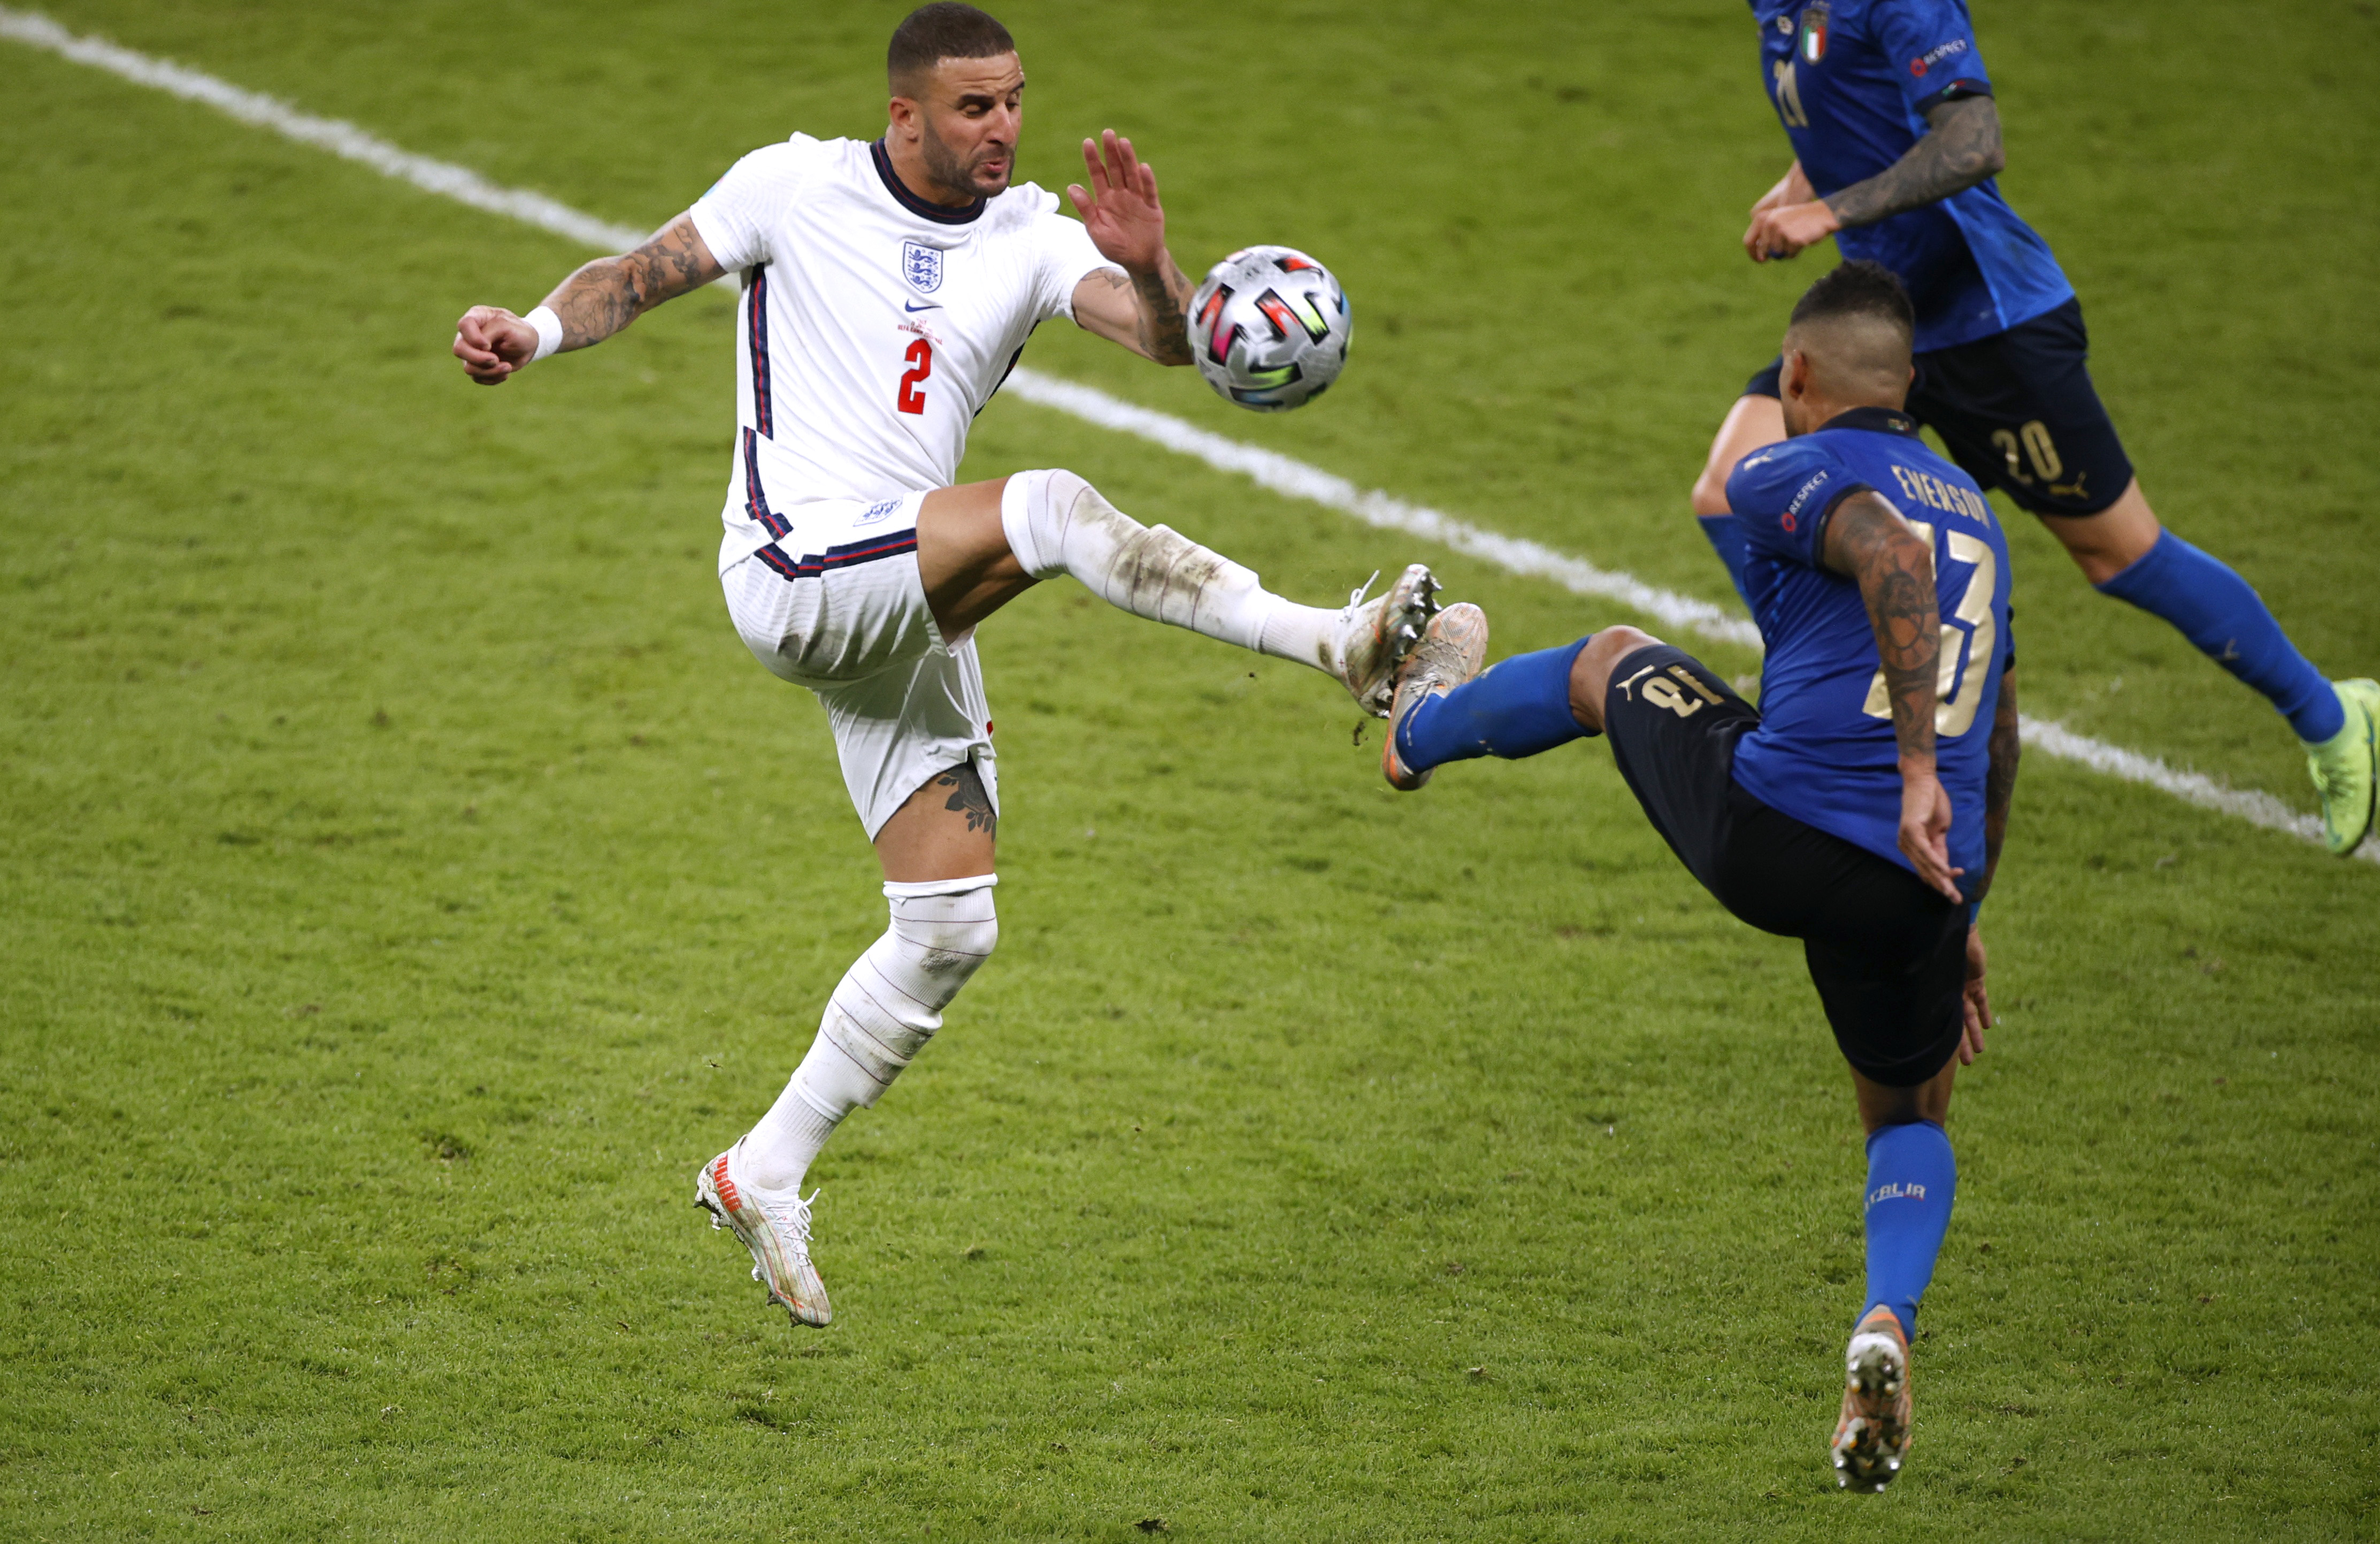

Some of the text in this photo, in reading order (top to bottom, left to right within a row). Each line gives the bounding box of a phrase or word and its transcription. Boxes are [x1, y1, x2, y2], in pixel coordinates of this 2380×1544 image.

[897, 338, 932, 415] 2
[1991, 420, 2063, 486] 20
[1789, 470, 1828, 516] RESPECT
[1891, 464, 1991, 530] EMERSON
[1640, 665, 1725, 718] 13
